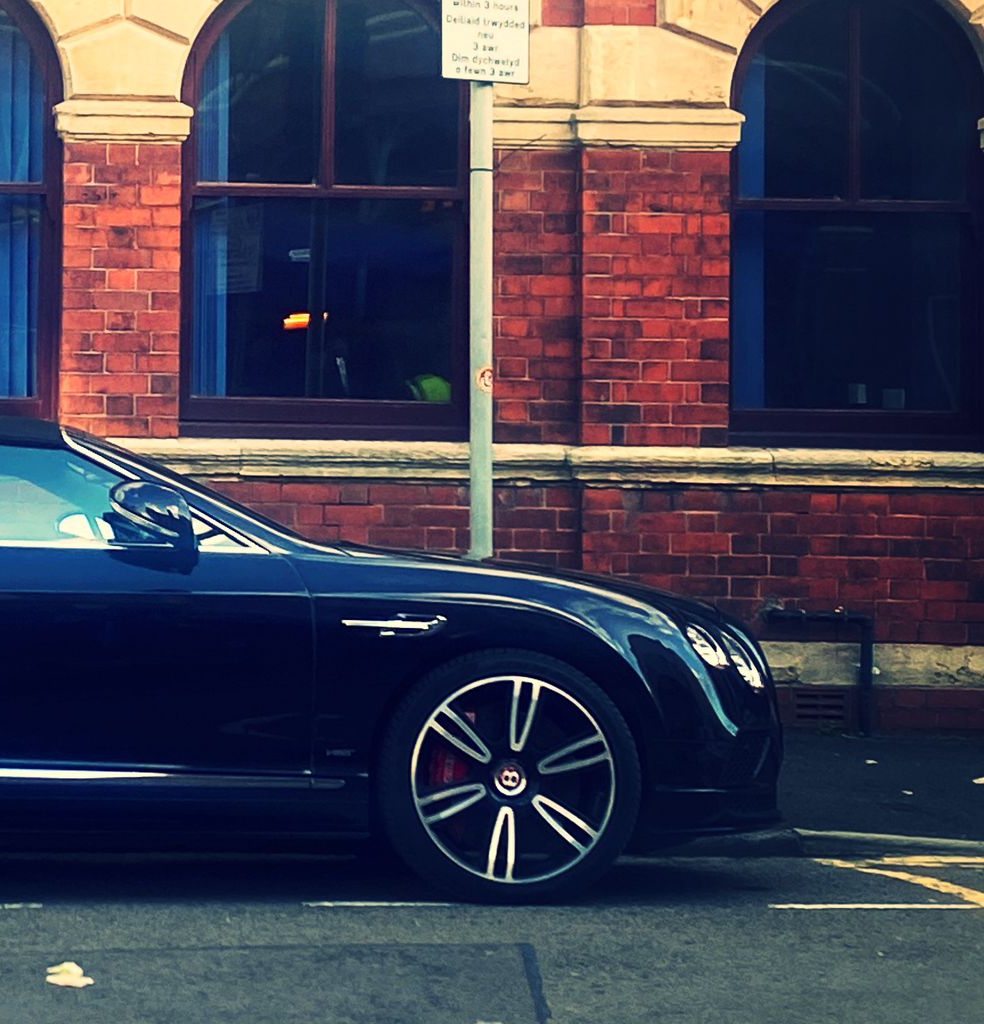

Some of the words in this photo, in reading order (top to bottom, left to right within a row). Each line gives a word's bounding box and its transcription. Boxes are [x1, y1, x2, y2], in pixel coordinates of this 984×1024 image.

[453, 0, 481, 8] within
[484, 1, 490, 9] 3
[493, 2, 518, 11] hours
[489, 68, 495, 76] 3
